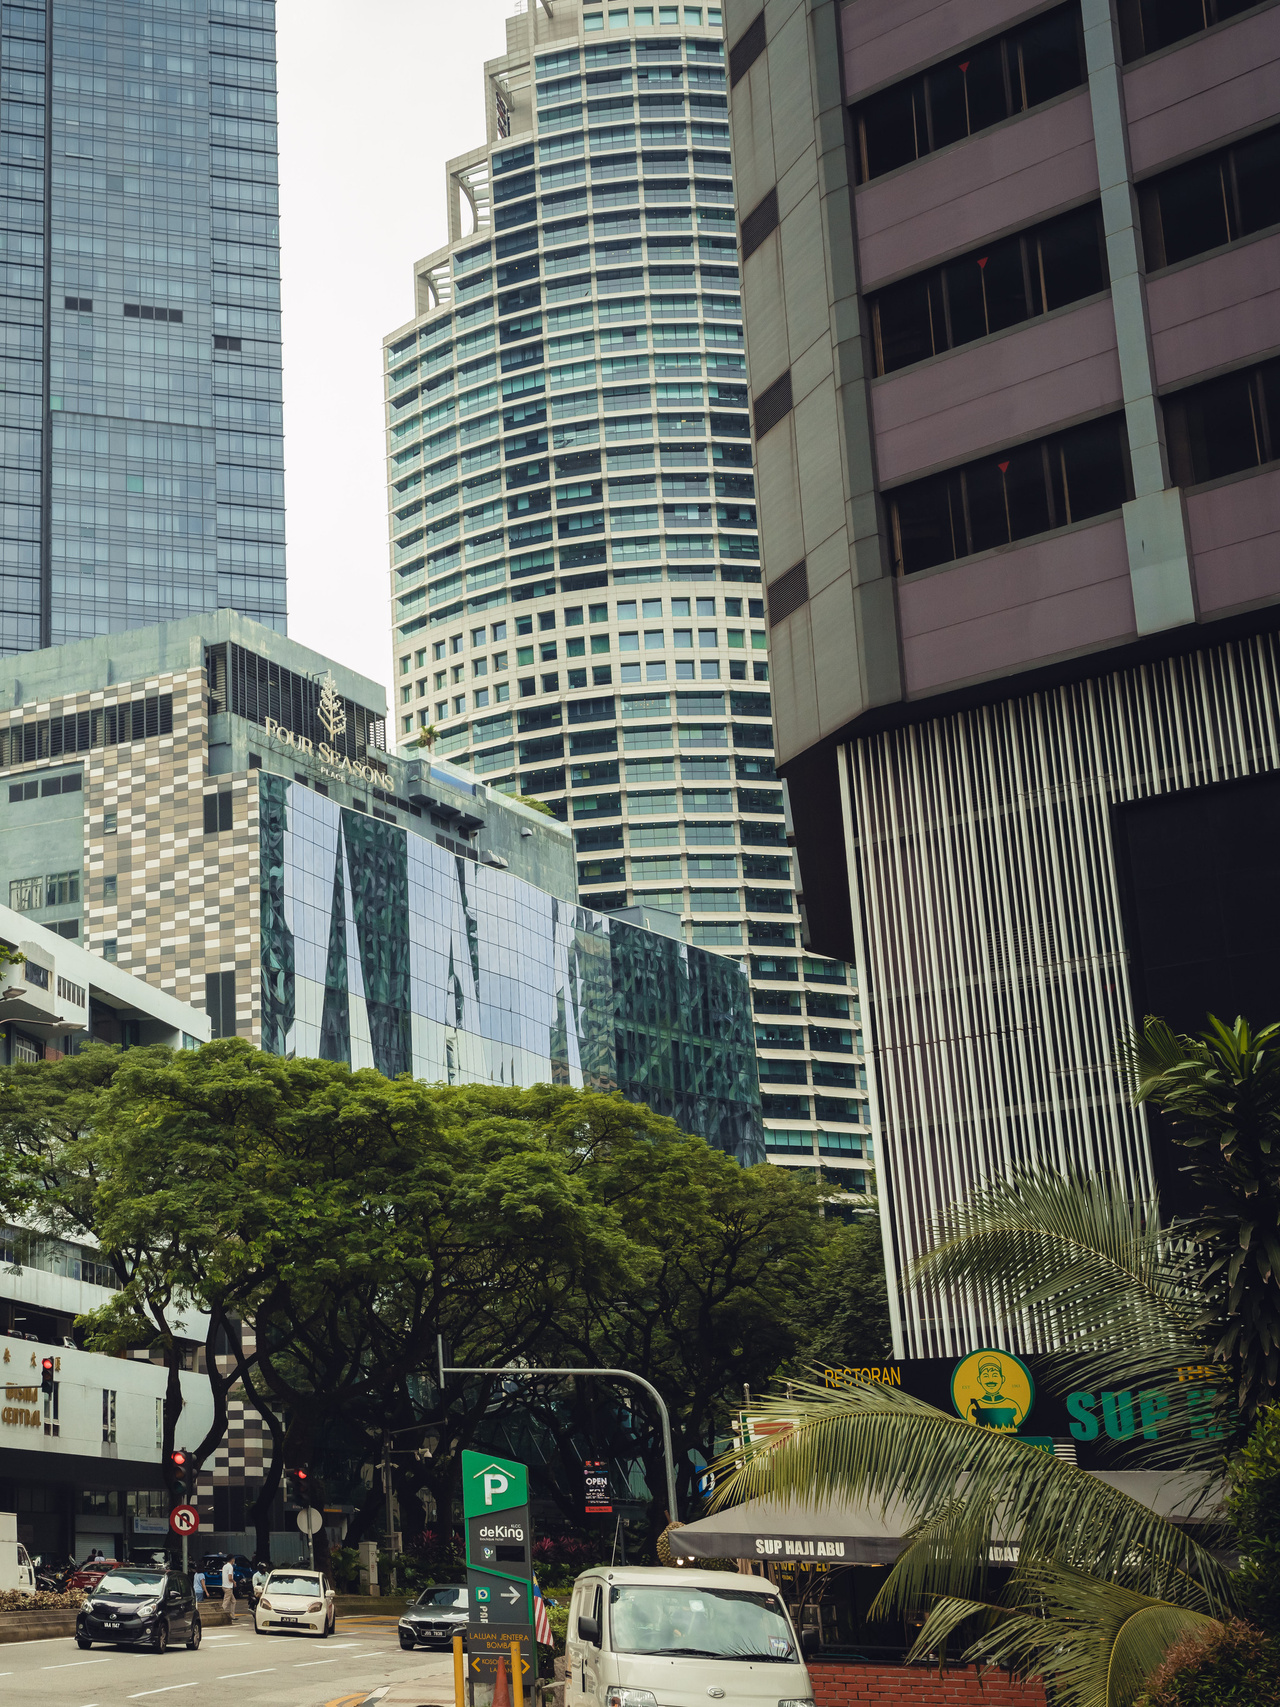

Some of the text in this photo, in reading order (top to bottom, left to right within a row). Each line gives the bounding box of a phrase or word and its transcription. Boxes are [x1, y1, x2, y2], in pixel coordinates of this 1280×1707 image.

[264, 716, 395, 792] FOUR SEASONS
[320, 766, 346, 784] PLACE
[824, 1366, 902, 1389] RESTORAN
[2, 1407, 41, 1427] CENTRAL
[1067, 1390, 1171, 1442] SUP
[484, 1473, 509, 1506] P
[585, 1477, 608, 1485] OPEN
[479, 1525, 524, 1541] deKing
[755, 1539, 845, 1557] SUP HAJI ABU
